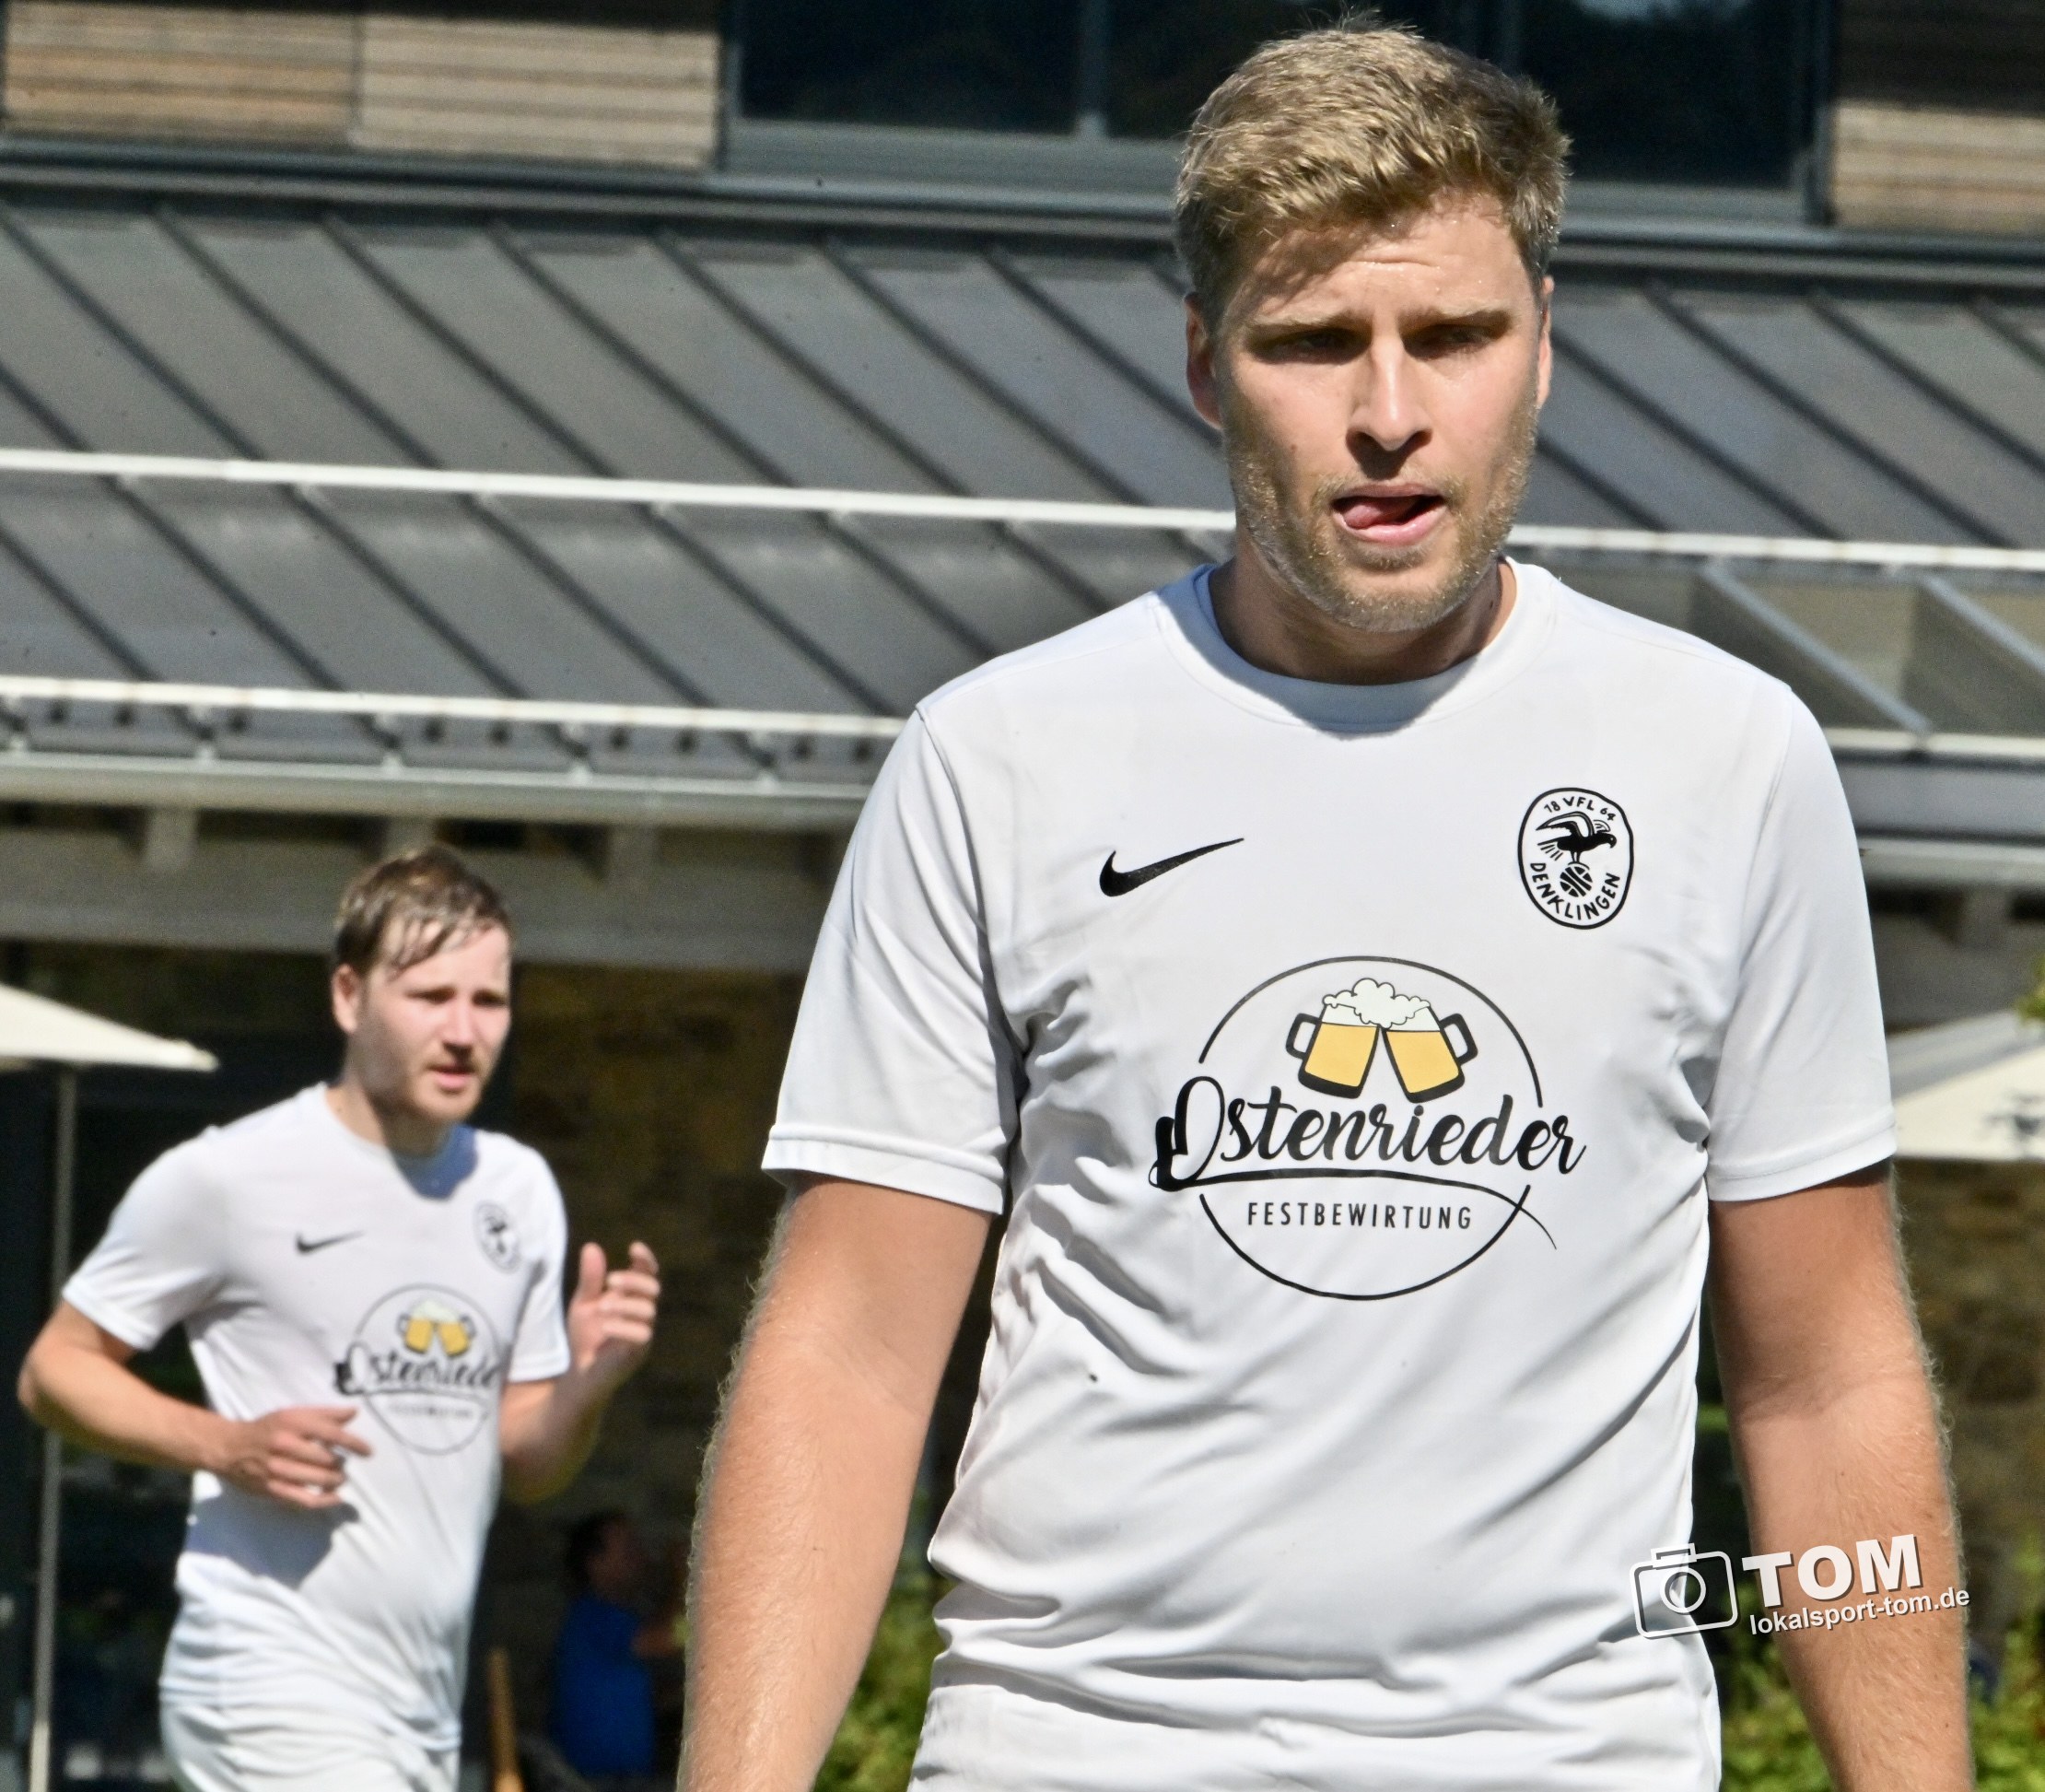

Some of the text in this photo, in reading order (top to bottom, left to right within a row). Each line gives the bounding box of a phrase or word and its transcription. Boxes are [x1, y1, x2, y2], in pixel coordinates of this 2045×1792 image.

[1543, 795, 1617, 822] 18 VFL 64
[1529, 862, 1621, 920] DENKLINGEN
[1148, 1075, 1587, 1192] Ostenrieder
[1247, 1201, 1472, 1230] FESTBEWIRTUNG
